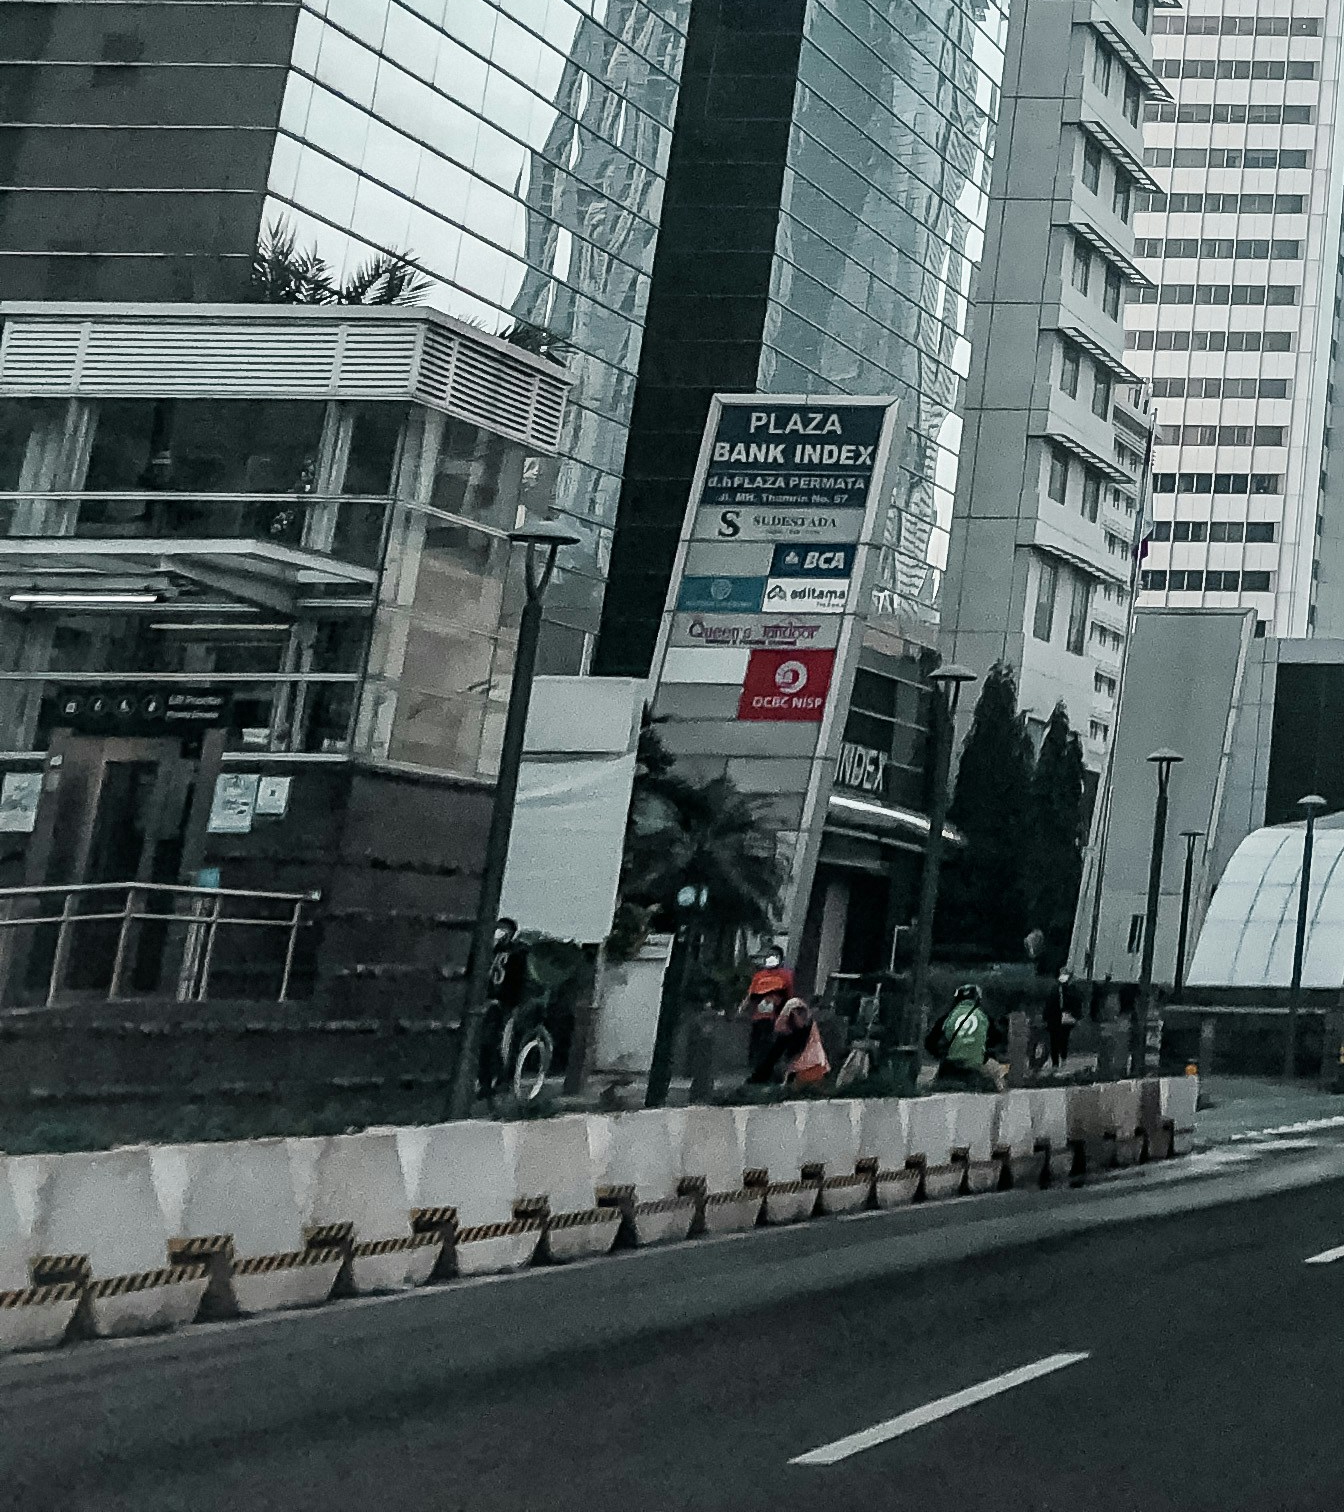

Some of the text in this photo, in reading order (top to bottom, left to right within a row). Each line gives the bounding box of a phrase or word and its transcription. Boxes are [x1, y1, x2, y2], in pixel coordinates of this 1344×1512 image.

[750, 412, 843, 435] PLAZA
[713, 442, 875, 466] BANK INDEX
[733, 476, 785, 488] PLAZA
[789, 477, 865, 490] PERMATA
[803, 551, 845, 570] BCA
[792, 697, 823, 709] NISP
[833, 742, 889, 792] INDEX
